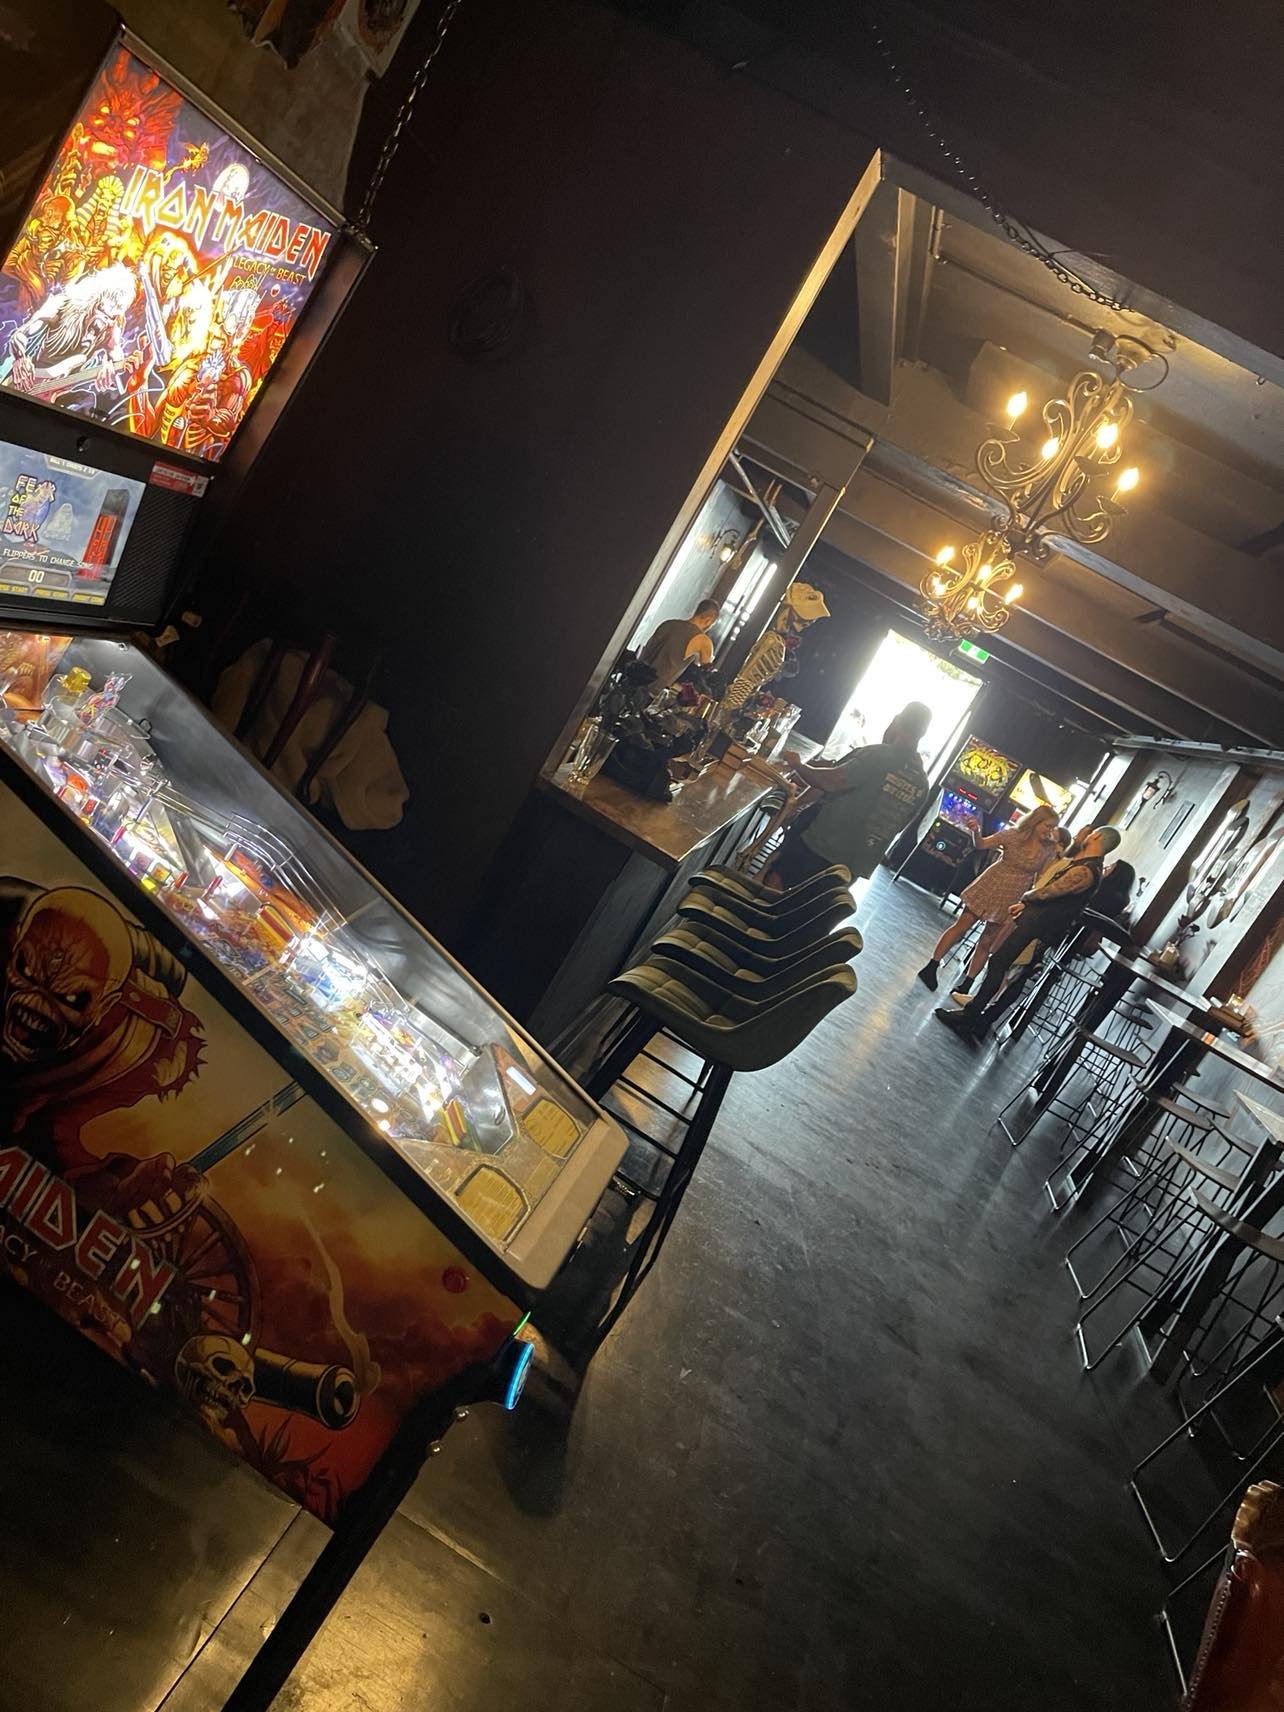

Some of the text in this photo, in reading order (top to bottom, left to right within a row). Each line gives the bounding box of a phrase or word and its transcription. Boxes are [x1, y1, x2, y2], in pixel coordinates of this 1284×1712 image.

[119, 164, 331, 282] IRON MAIDEN
[233, 255, 271, 275] LEGACY
[276, 267, 307, 287] BEAST
[3, 548, 36, 561] FLIPPERS
[39, 555, 48, 563] TO
[28, 569, 45, 583] 00
[0, 1146, 179, 1330] AIDEN
